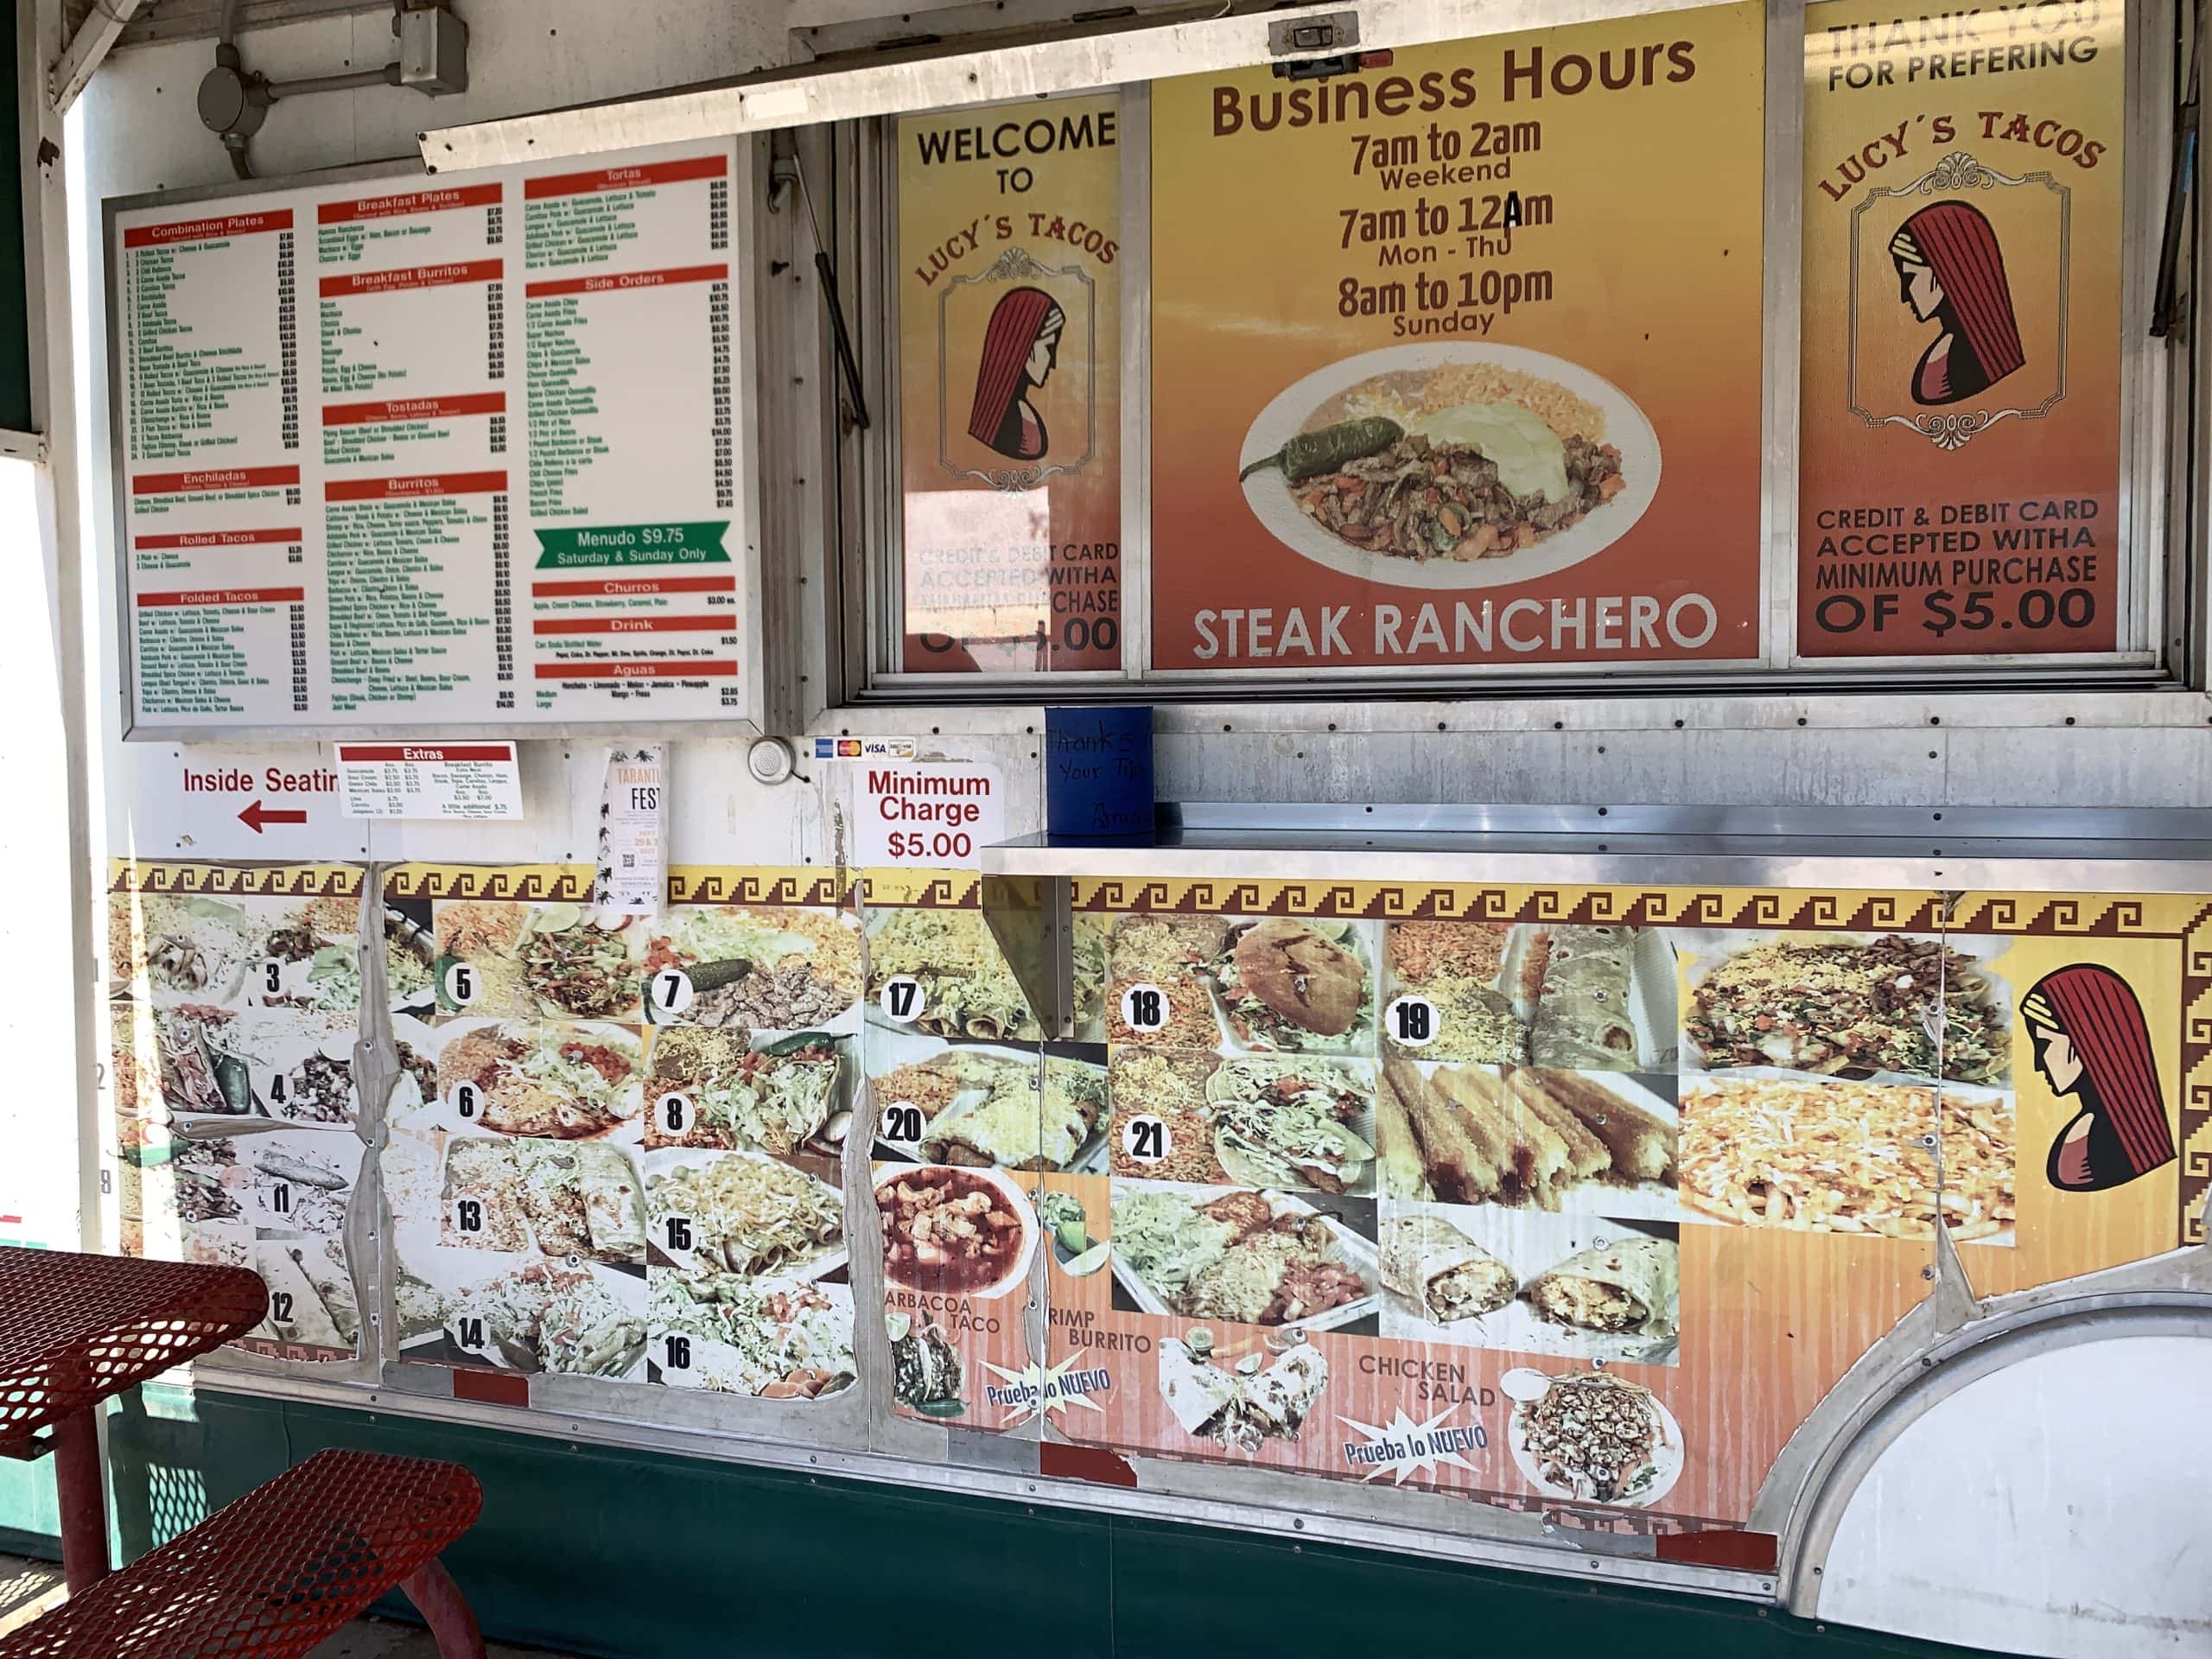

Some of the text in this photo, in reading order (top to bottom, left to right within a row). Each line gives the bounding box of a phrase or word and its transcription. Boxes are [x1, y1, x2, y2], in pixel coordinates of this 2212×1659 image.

[1827, 8, 1980, 59] THANK
[1828, 35, 2098, 91] FOR PREFERING
[1212, 41, 1696, 137] Business Hours
[917, 111, 1116, 165] WELCOME
[1351, 120, 1541, 175] 7am to 2am
[1978, 111, 2107, 168] TACOS
[607, 168, 641, 181] Tortas
[996, 167, 1033, 194] TO
[1380, 157, 1511, 191] Weekend
[358, 194, 416, 212] Breakfast
[421, 191, 460, 203] Plates
[151, 220, 224, 238] Combination
[228, 216, 264, 228] Plates
[1339, 207, 1406, 249] 7am
[1415, 198, 1449, 235] to
[1028, 213, 1119, 264] TACOS
[1379, 245, 1437, 266] Mon
[352, 265, 468, 286] Breakfast Burritos
[585, 273, 664, 290] Side Orders
[1338, 270, 1553, 317] 8am to 10pm
[1393, 312, 1495, 337] Sunday
[386, 400, 439, 413] Tostadas
[183, 470, 246, 485] Enchiladas
[388, 478, 439, 490] Burritos
[1816, 499, 2099, 531] CREDIT & DEBIT CARD
[180, 533, 256, 546] Rolled Tacos
[578, 527, 684, 547] Menudo $9.75
[1816, 531, 1980, 557] ACCEPTED
[557, 547, 707, 565] Saturday & Sunday Only
[1063, 543, 1118, 561] CARD
[1816, 556, 2097, 589] MINIMUM PURCHASE
[181, 591, 259, 604] Folded Tacos
[604, 582, 660, 594] Churros
[611, 620, 654, 632] Drink
[1193, 593, 1718, 659] STEAK RANCHERO
[1815, 588, 2095, 638] OF $5.00
[613, 664, 656, 677] Aguas
[403, 747, 444, 760] Extras
[865, 744, 887, 753] VISA
[184, 767, 254, 792] Inside
[265, 767, 340, 792] Seatin
[868, 771, 991, 796] Minimum
[880, 796, 980, 827] Charge
[888, 833, 972, 859] $5.00
[266, 963, 280, 993] 3
[456, 969, 472, 1000] 5
[664, 975, 680, 1007] 7
[889, 983, 914, 1015] 17
[1130, 991, 1160, 1025] 18
[1397, 1002, 1429, 1040] 19
[270, 1074, 286, 1103] 4
[458, 1087, 474, 1118] 6
[666, 1098, 683, 1130] 8
[887, 1108, 921, 1141] 20
[1133, 1122, 1162, 1159] 21
[273, 1185, 289, 1212] 11
[457, 1201, 481, 1232] 13
[666, 1217, 692, 1250] 15
[272, 1292, 293, 1322] 12
[884, 1291, 972, 1314] ARBACOA
[1050, 1307, 1095, 1327] RIMP
[458, 1319, 485, 1349] 14
[951, 1315, 1001, 1334] TACO
[666, 1337, 690, 1370] 16
[1068, 1327, 1152, 1354] BURRITO
[1359, 1355, 1465, 1384] CHICKEN
[987, 1380, 1037, 1407] Prueba
[1058, 1368, 1111, 1396] NUEVO
[1418, 1381, 1496, 1408] SALAD
[1344, 1424, 1488, 1465] Prueba lo NUEVO
